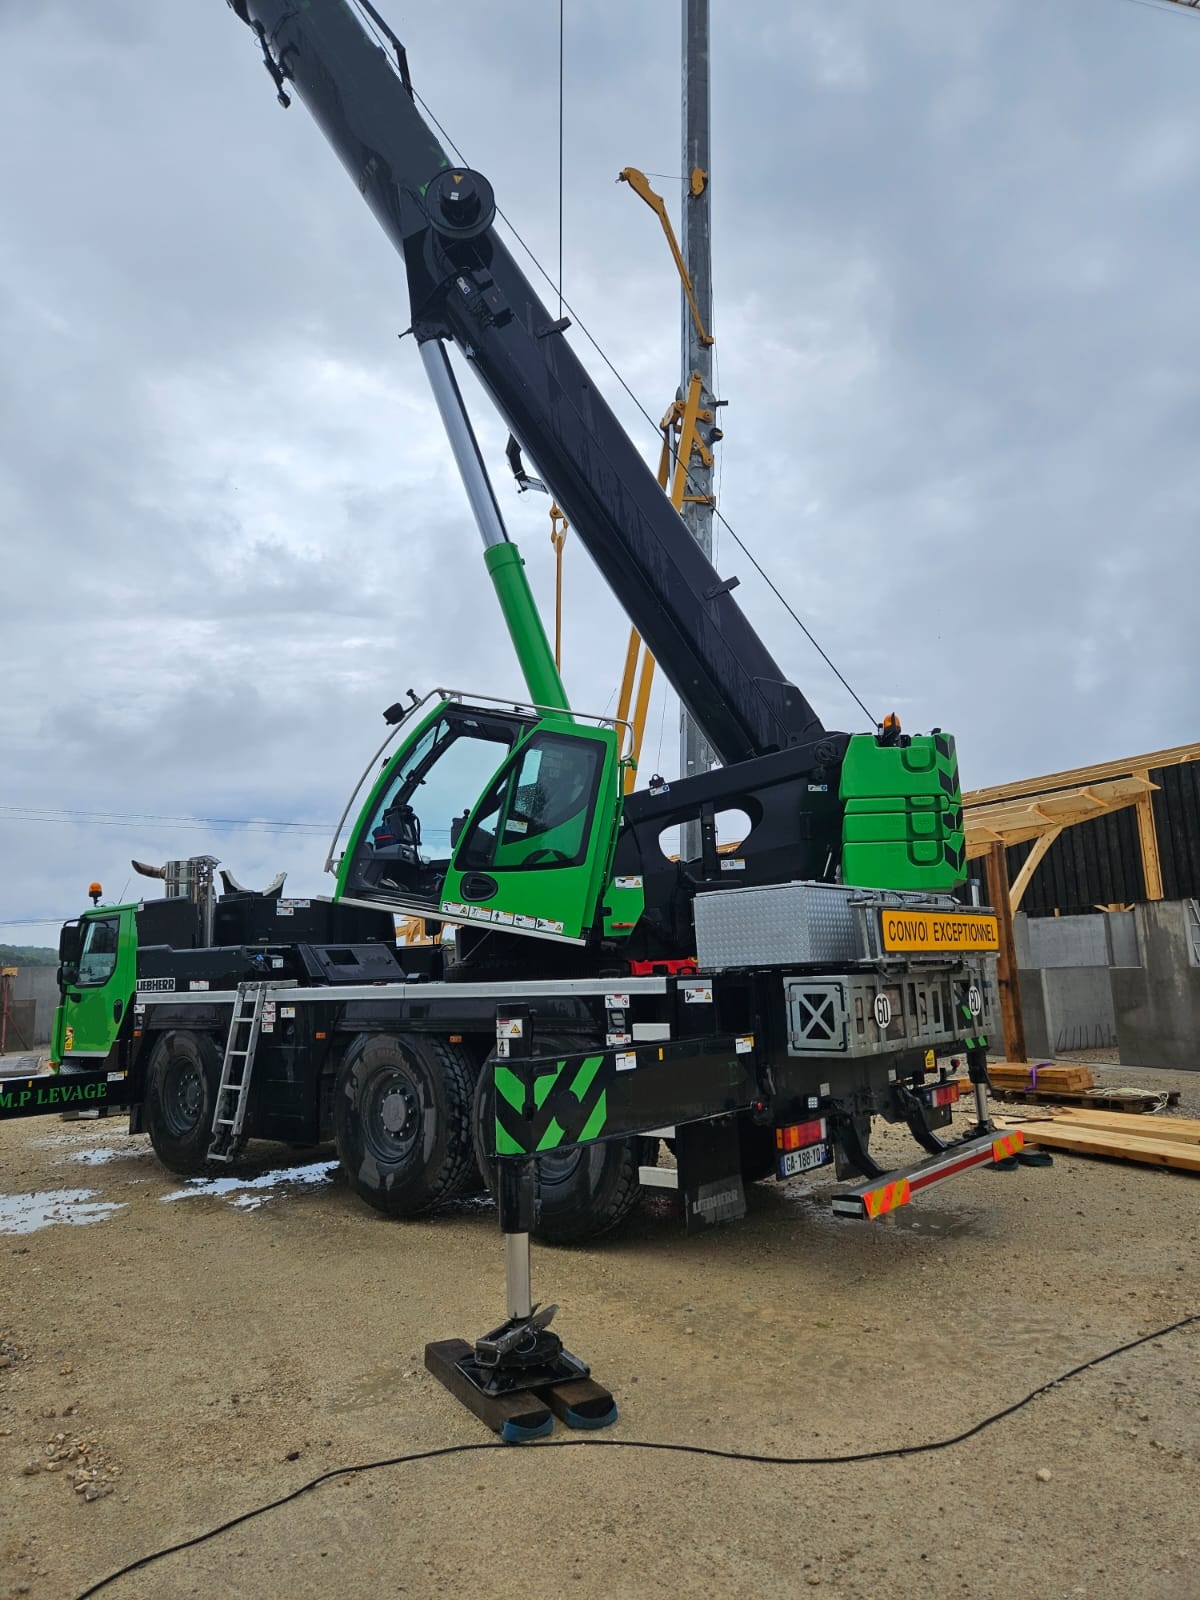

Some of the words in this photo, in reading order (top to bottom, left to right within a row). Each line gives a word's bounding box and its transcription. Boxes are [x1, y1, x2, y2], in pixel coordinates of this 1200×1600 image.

[888, 920, 928, 942] CONVOI
[933, 922, 996, 942] EXCEPTIONNEL
[137, 979, 174, 991] LIEBHERR
[877, 997, 888, 1024] 60
[970, 989, 979, 1012] 80
[37, 1083, 107, 1104] LEVAGE
